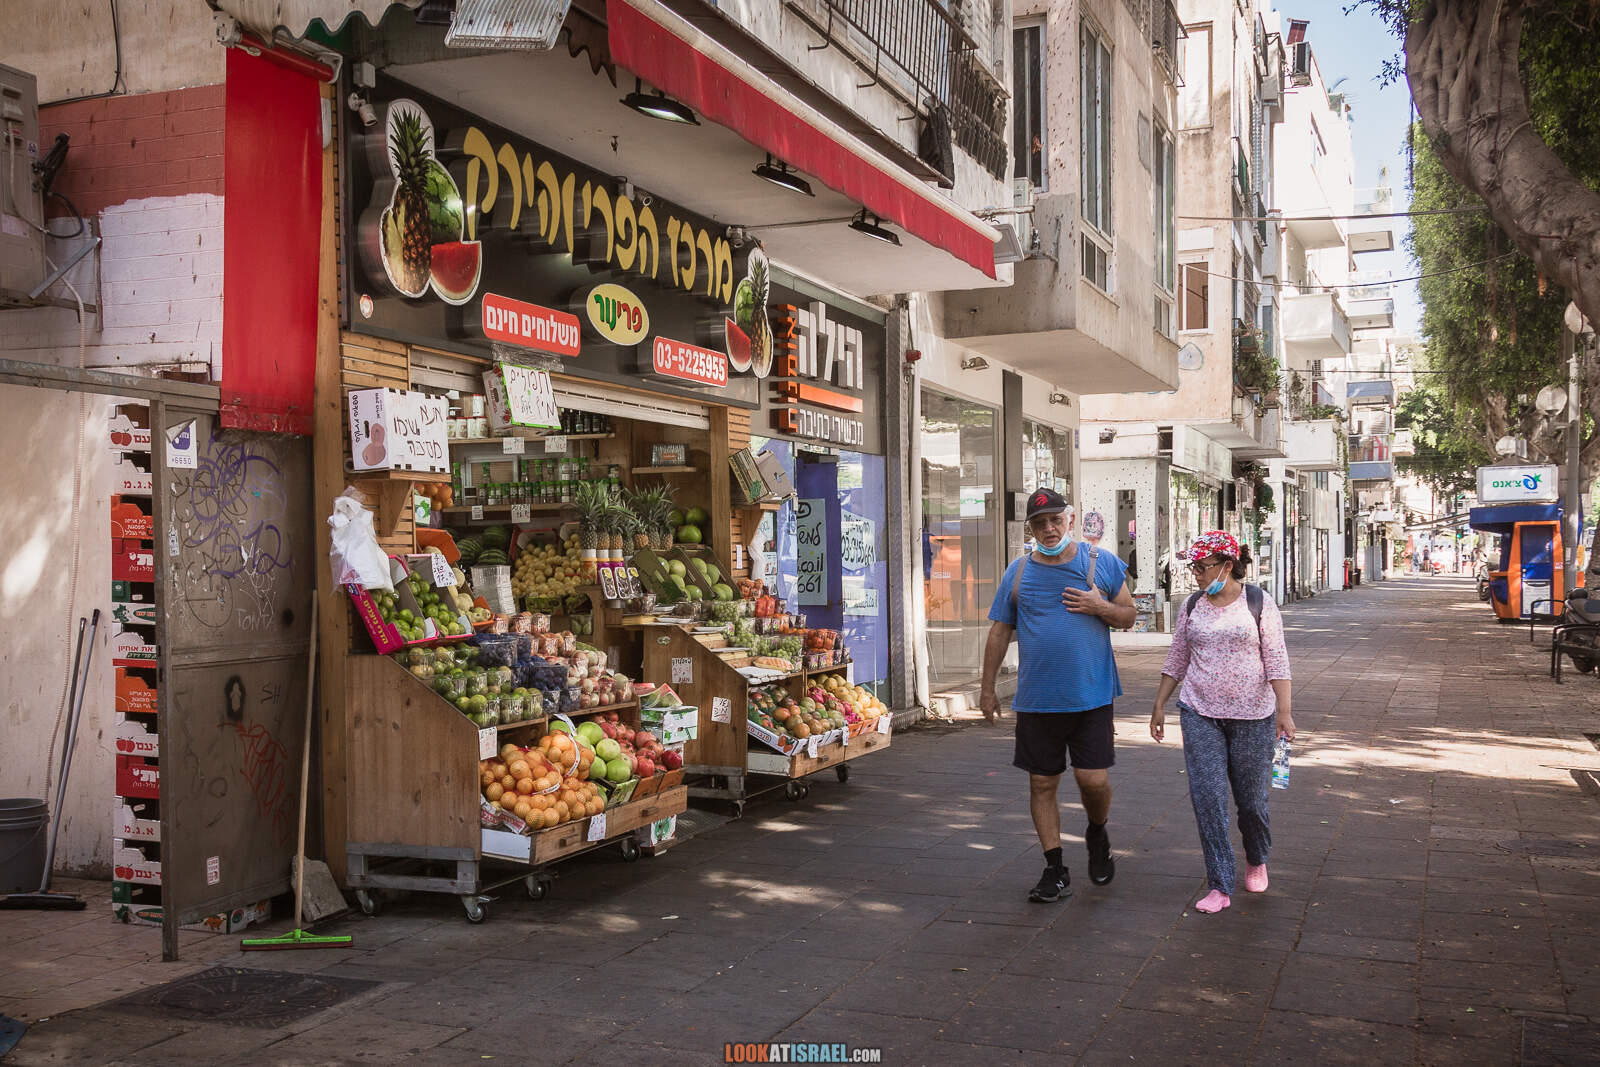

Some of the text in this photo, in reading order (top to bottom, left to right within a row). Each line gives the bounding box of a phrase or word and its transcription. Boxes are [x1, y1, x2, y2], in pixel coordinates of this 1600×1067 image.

[667, 215, 732, 304] מרכז
[486, 305, 578, 349] משלוחים חינם
[798, 301, 863, 390] הילה
[656, 342, 726, 382] 03-5225955
[394, 416, 420, 437] שימו
[419, 404, 443, 426] אנא
[799, 408, 864, 446] מכשירי כתיבה
[1492, 480, 1522, 488] צ'אנס
